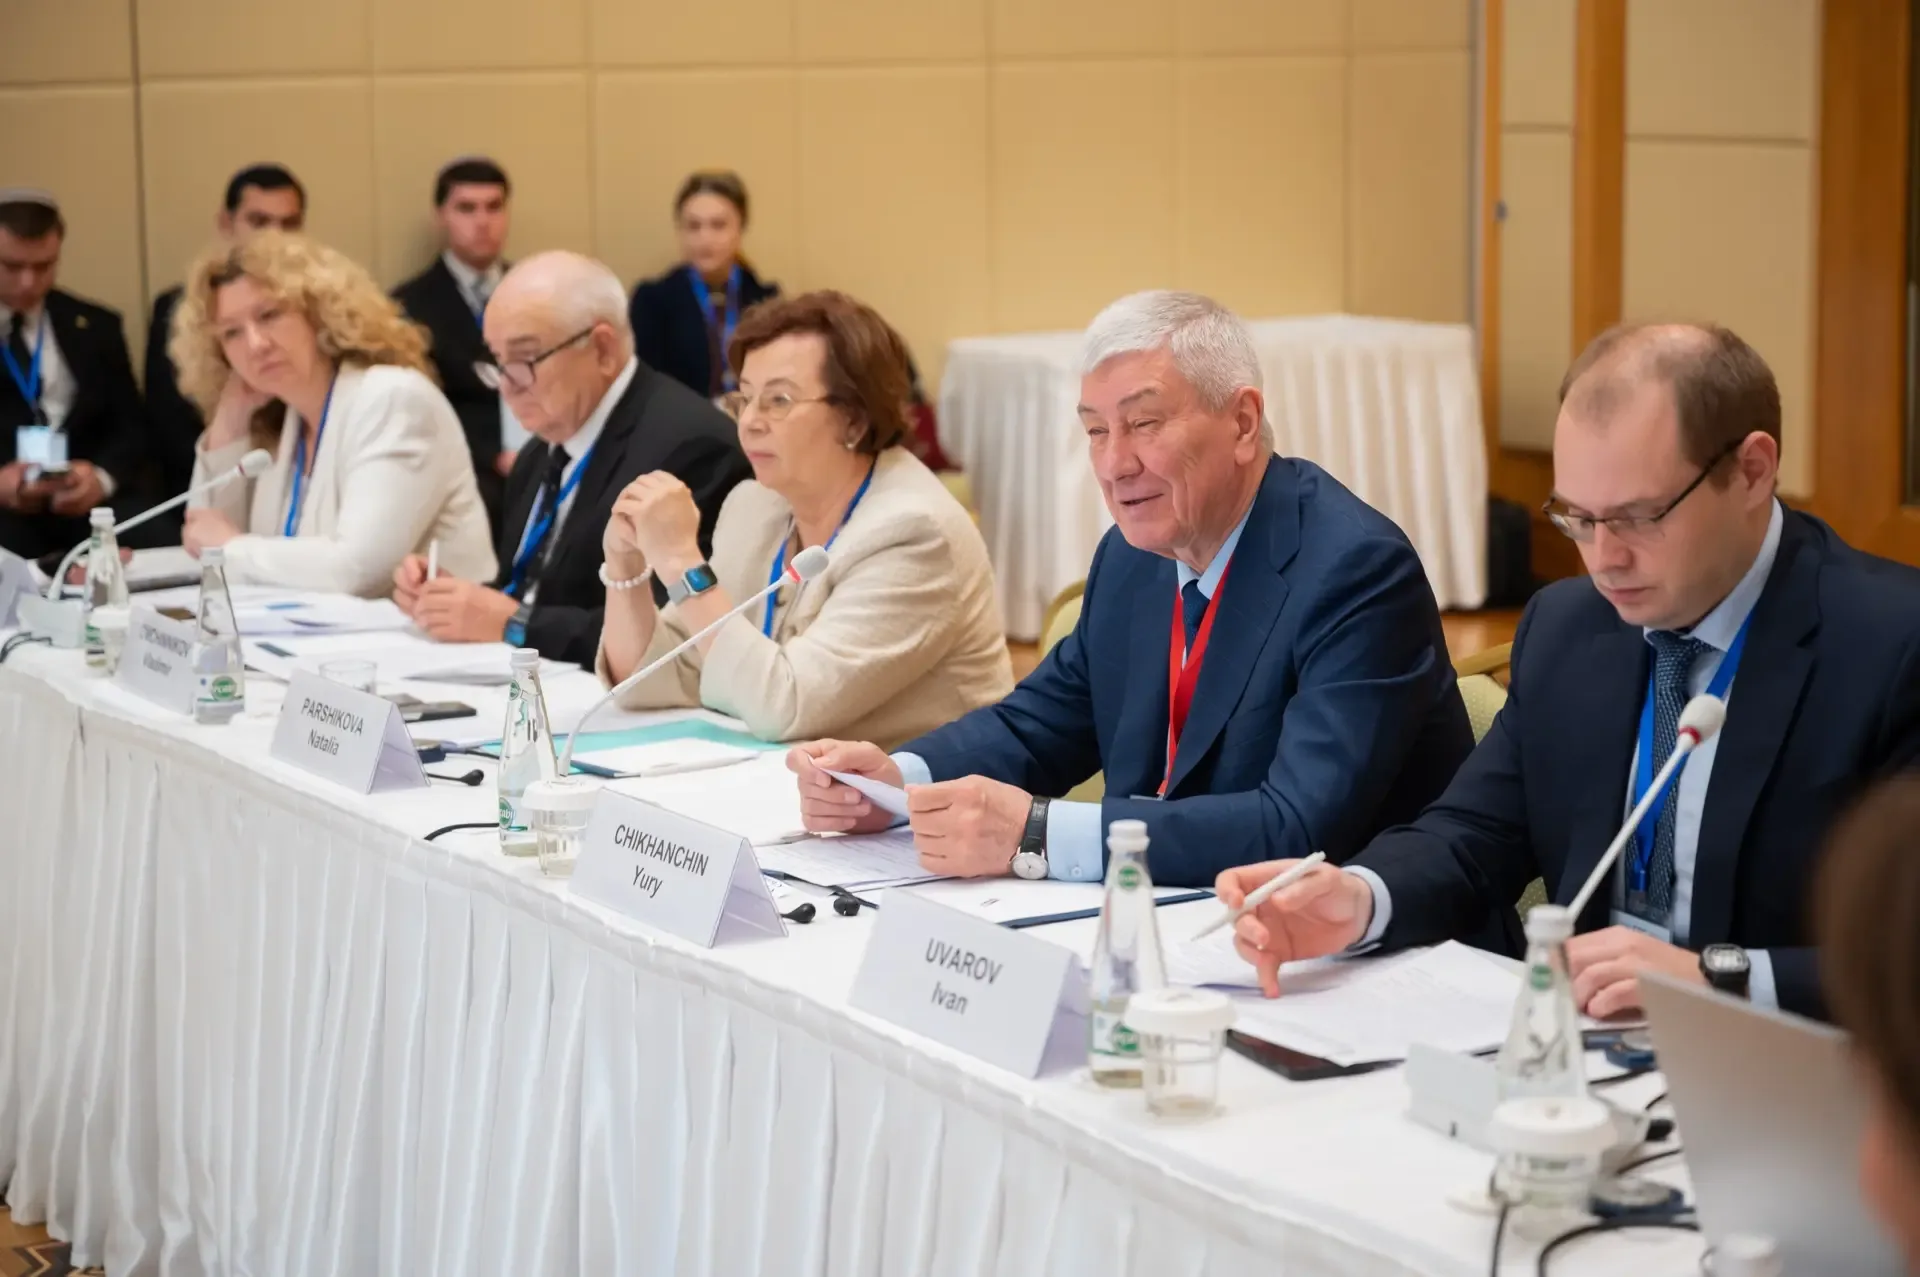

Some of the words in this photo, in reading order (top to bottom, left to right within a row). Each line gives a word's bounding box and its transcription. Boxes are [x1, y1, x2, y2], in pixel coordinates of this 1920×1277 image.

[301, 698, 364, 736] PARSHIKOVA
[307, 729, 339, 756] Natalia
[614, 824, 709, 876] CHIKHANCHIN
[632, 865, 663, 899] Yury
[925, 938, 1003, 984] UVAROV
[931, 981, 968, 1015] Ivan
